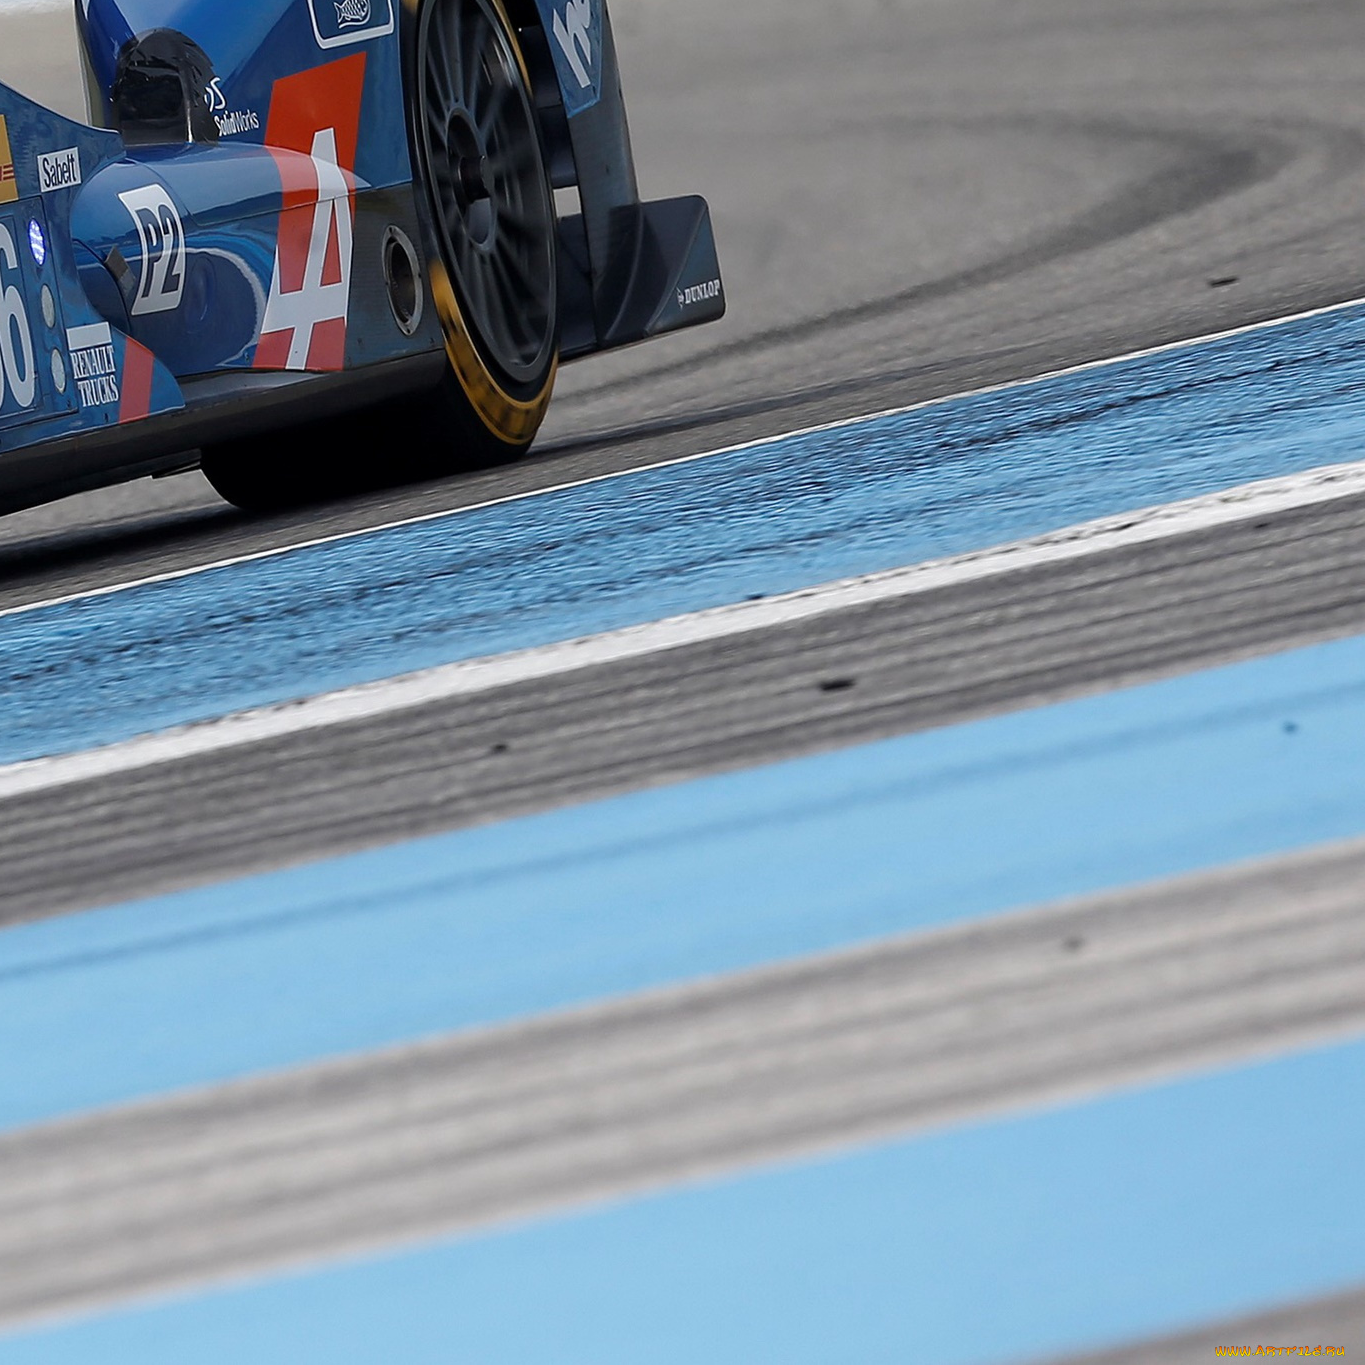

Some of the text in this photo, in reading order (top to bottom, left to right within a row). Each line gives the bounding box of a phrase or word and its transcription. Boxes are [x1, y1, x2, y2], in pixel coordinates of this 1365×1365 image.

[42, 153, 77, 188] Sabelt
[135, 204, 181, 299] P2
[684, 279, 720, 305] DUNLOP
[69, 345, 116, 379] RENAULT
[77, 374, 119, 407] TRUCKS
